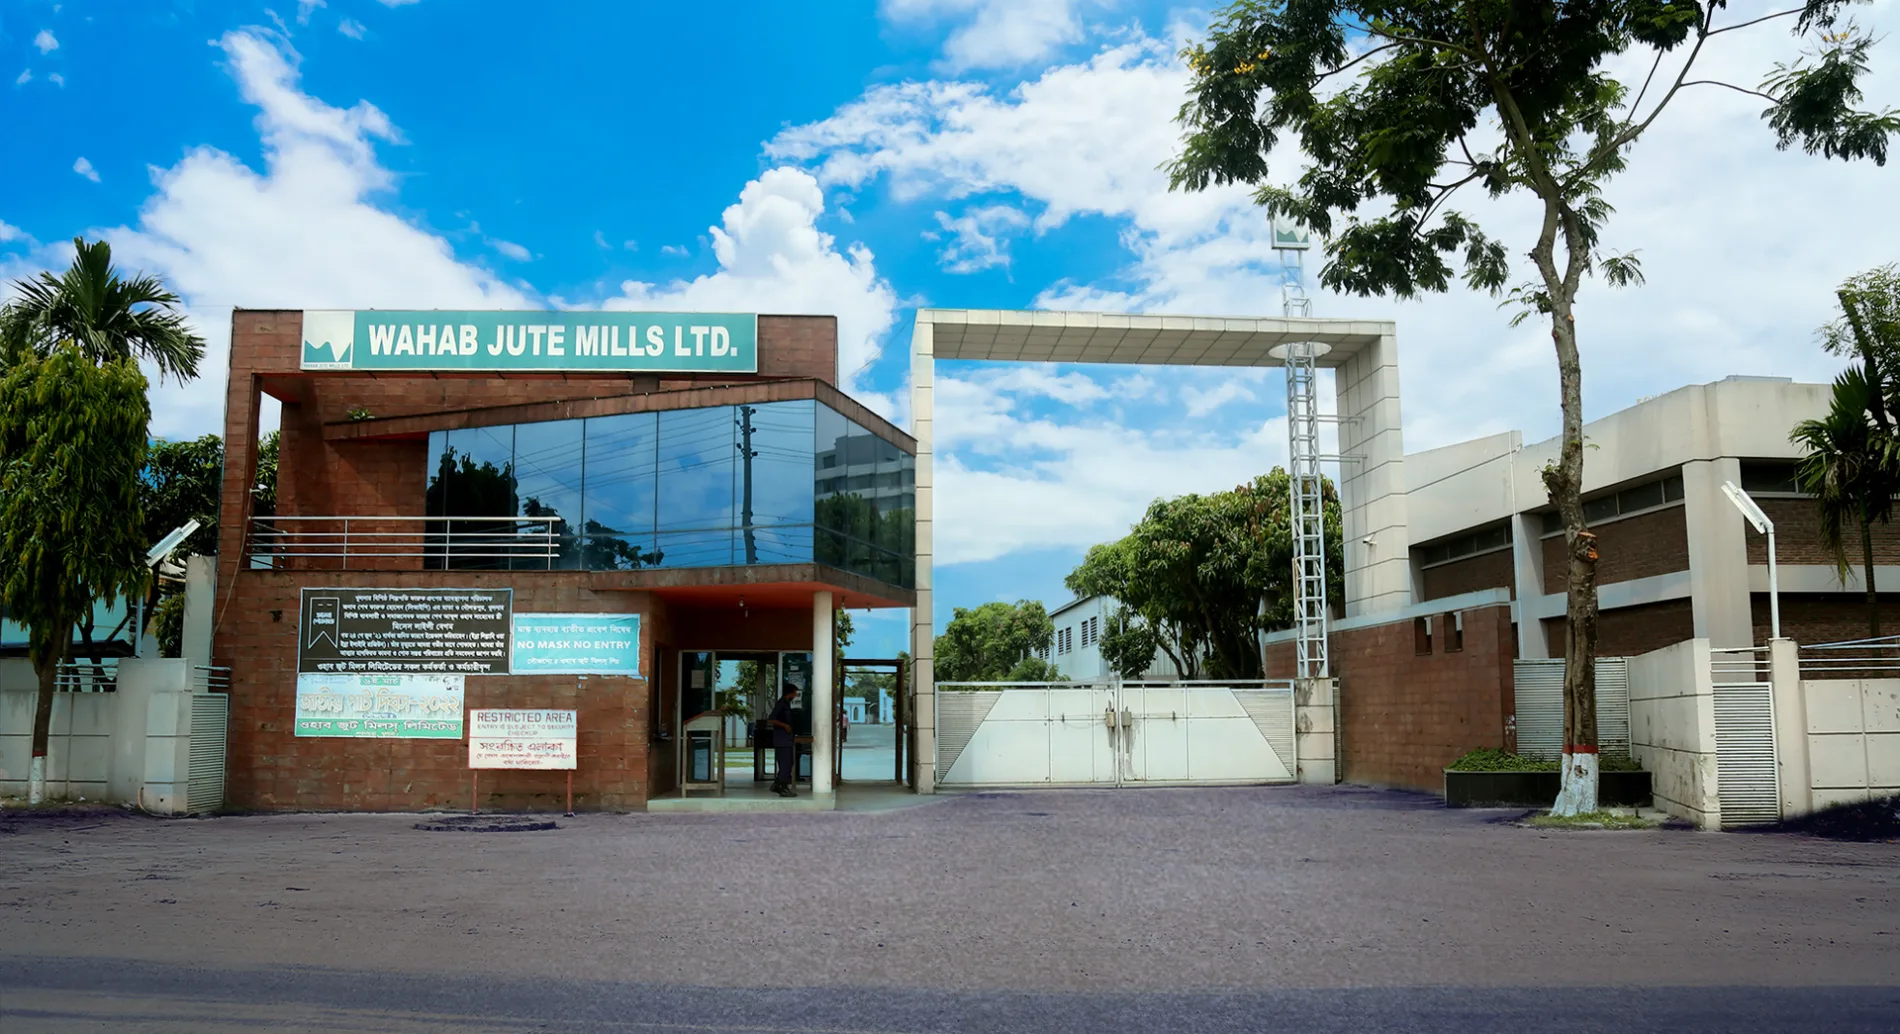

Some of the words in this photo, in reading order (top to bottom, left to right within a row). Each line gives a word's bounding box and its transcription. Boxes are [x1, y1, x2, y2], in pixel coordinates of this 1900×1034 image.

[368, 324, 478, 356] WAHAB
[487, 324, 565, 356] JUTE
[576, 324, 664, 356] MILLS
[674, 324, 738, 356] LTD.
[517, 641, 534, 649] NO
[537, 641, 570, 649] MASK
[574, 641, 591, 649] NO
[594, 641, 631, 649] ENTRY
[300, 687, 344, 712] জাতীয়
[348, 689, 372, 712] পাট
[477, 712, 541, 722] RESTRICTED
[546, 712, 572, 722] AREA
[300, 721, 332, 730] ওহাব
[336, 720, 358, 731] জুট
[480, 739, 523, 751] সংরক্ষিত
[527, 742, 563, 751] এলাকা
